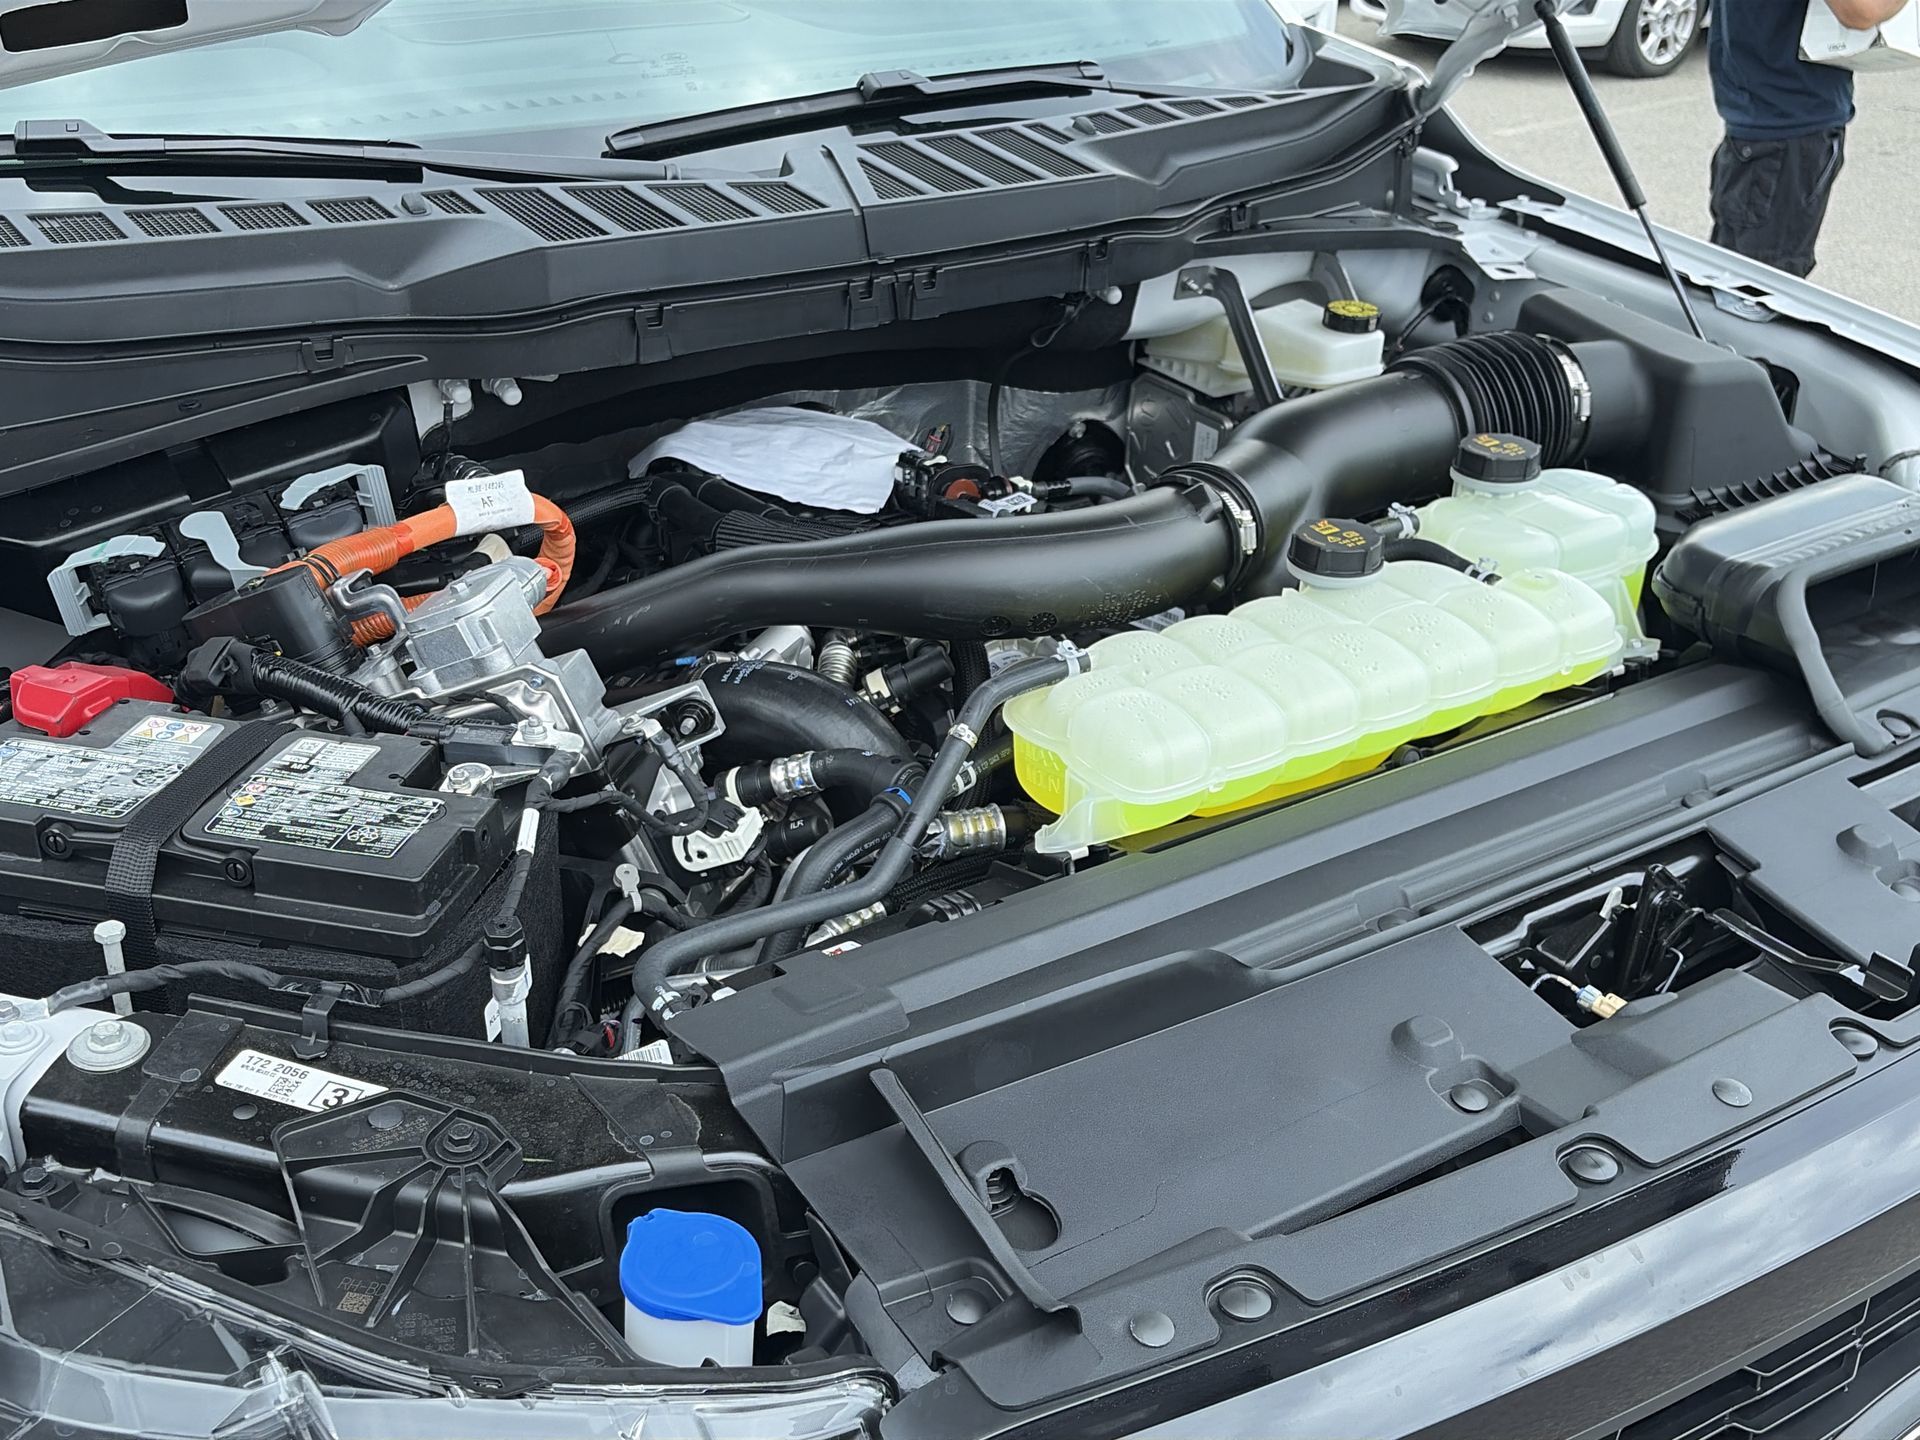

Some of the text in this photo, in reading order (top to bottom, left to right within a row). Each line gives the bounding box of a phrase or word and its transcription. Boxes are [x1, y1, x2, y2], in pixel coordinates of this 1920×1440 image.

[480, 495, 494, 509] AF
[290, 763, 311, 771] MF
[245, 1055, 272, 1069] 172
[273, 1063, 310, 1080] 2056
[322, 1087, 350, 1109] 3
